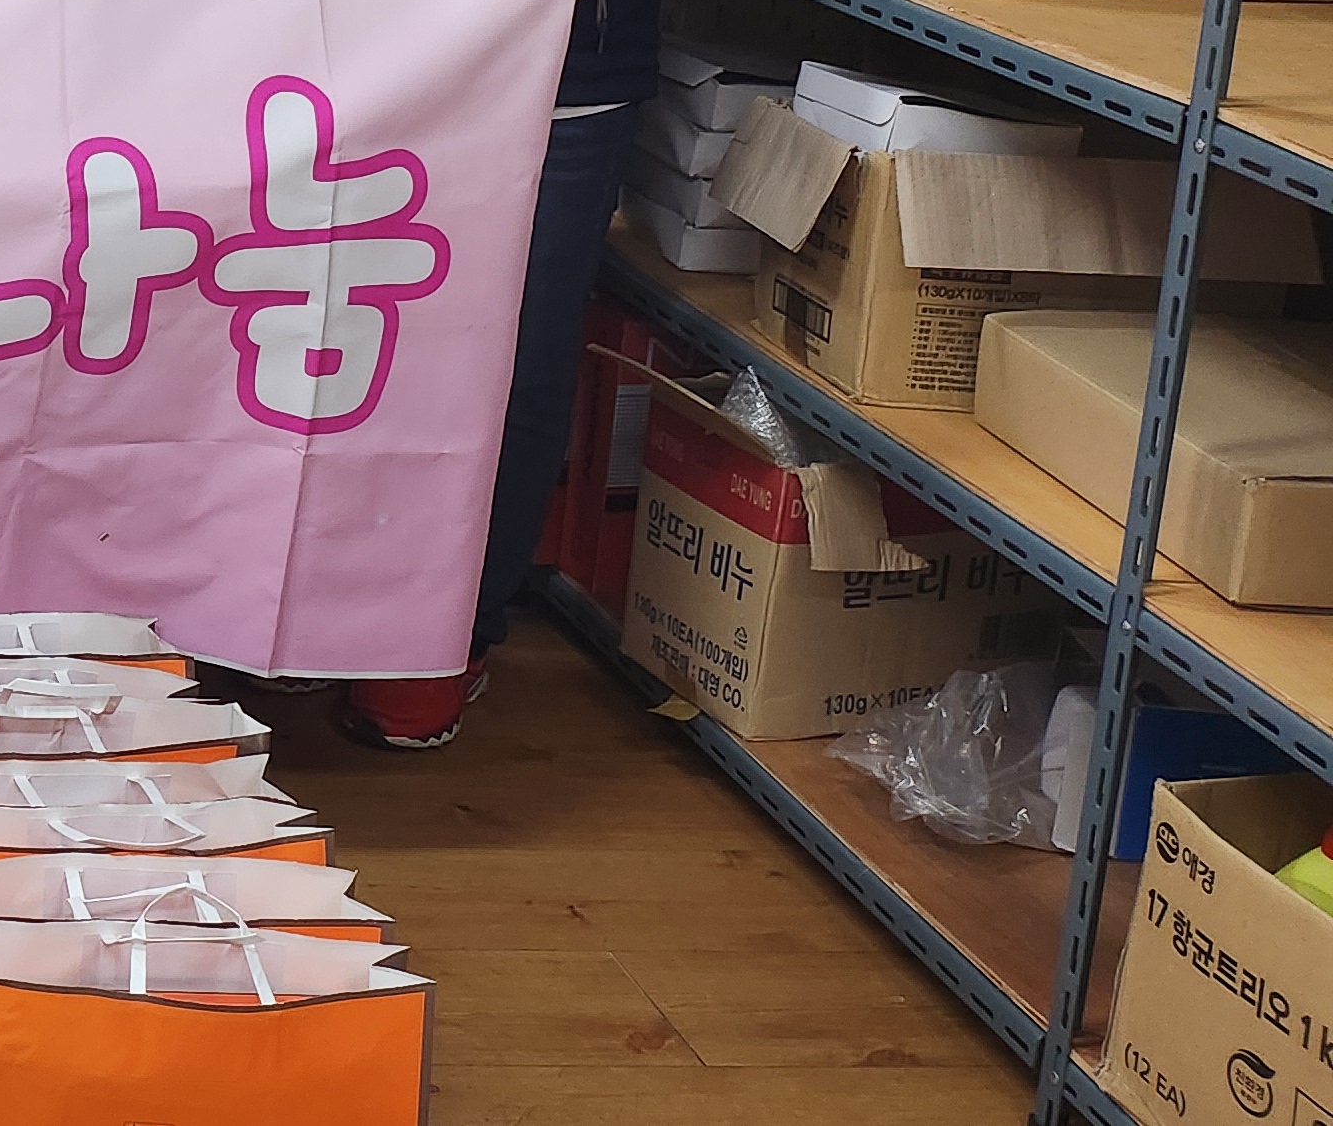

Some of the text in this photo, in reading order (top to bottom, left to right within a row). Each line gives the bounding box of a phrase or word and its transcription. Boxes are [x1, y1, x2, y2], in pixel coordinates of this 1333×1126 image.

[730, 474, 747, 498] DAE
[748, 480, 773, 511] YUNG
[647, 499, 754, 601] 알뜨리 비누
[697, 666, 720, 698] 대영
[722, 682, 745, 713] CO.
[1182, 847, 1215, 894] 애경
[1148, 888, 1168, 928] 17
[1173, 909, 1289, 1035] 항균트리오
[1124, 1041, 1185, 1117] (12 EA)
